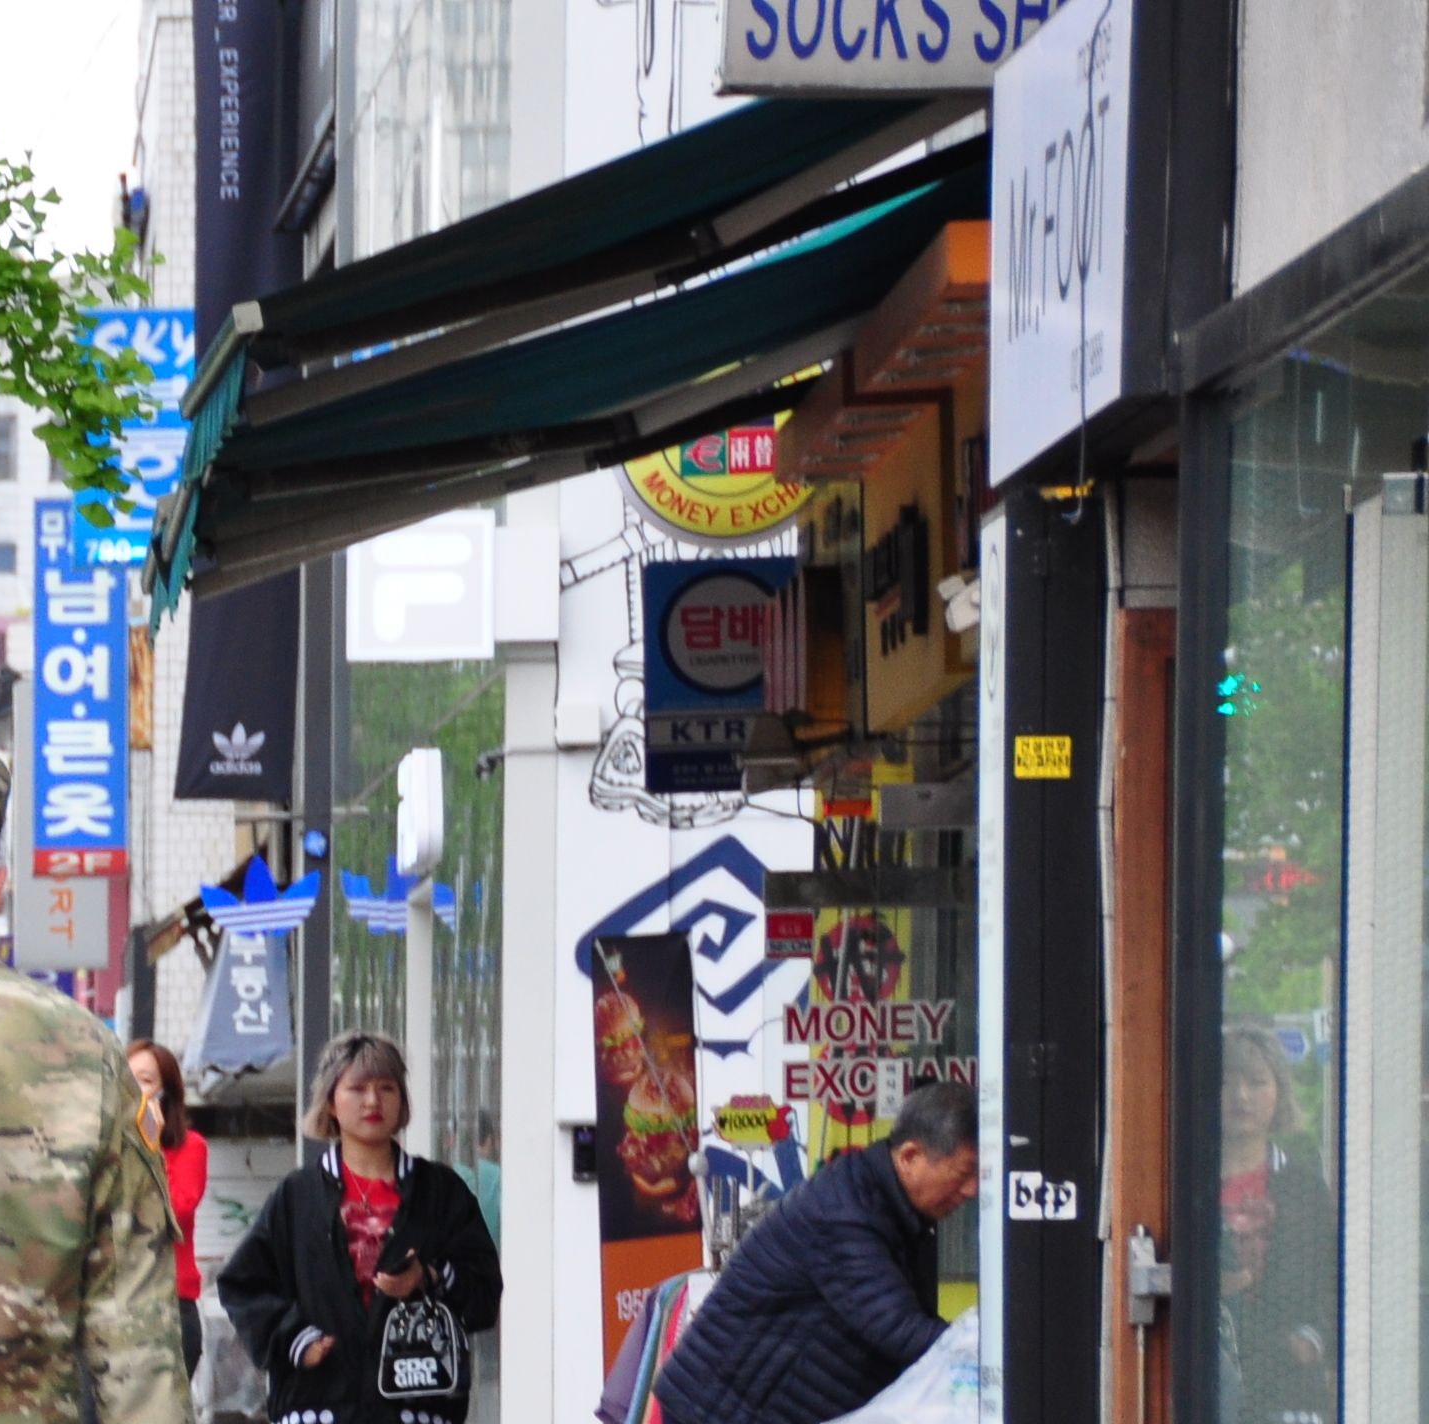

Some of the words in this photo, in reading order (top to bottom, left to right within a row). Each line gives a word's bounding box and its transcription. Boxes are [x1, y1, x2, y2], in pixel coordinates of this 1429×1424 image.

[219, 48, 240, 200] EXPERIENCE
[643, 469, 719, 528] MONEY
[210, 760, 263, 776] adidas
[48, 852, 113, 876] 2F
[786, 1005, 949, 1044] MONEY
